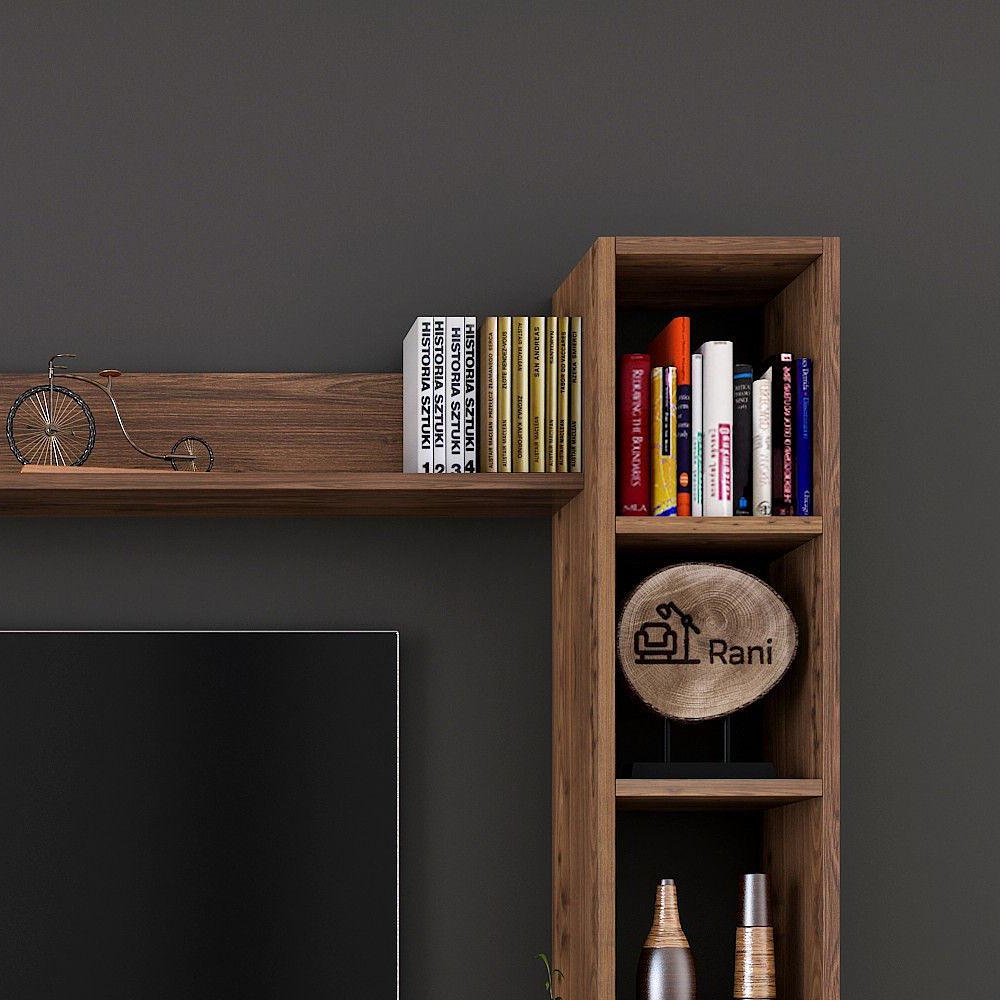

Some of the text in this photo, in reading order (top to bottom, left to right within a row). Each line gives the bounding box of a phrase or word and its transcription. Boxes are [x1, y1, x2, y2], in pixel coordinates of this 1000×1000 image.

[421, 322, 431, 474] HISTORIA SZTUKI 1
[434, 321, 445, 474] HISTORIA SZTUKI 2
[451, 327, 462, 474] HISTORIA SZTUKI 3
[465, 324, 475, 474] HISTORIA SZTUKI 4
[709, 638, 773, 665] Rani
